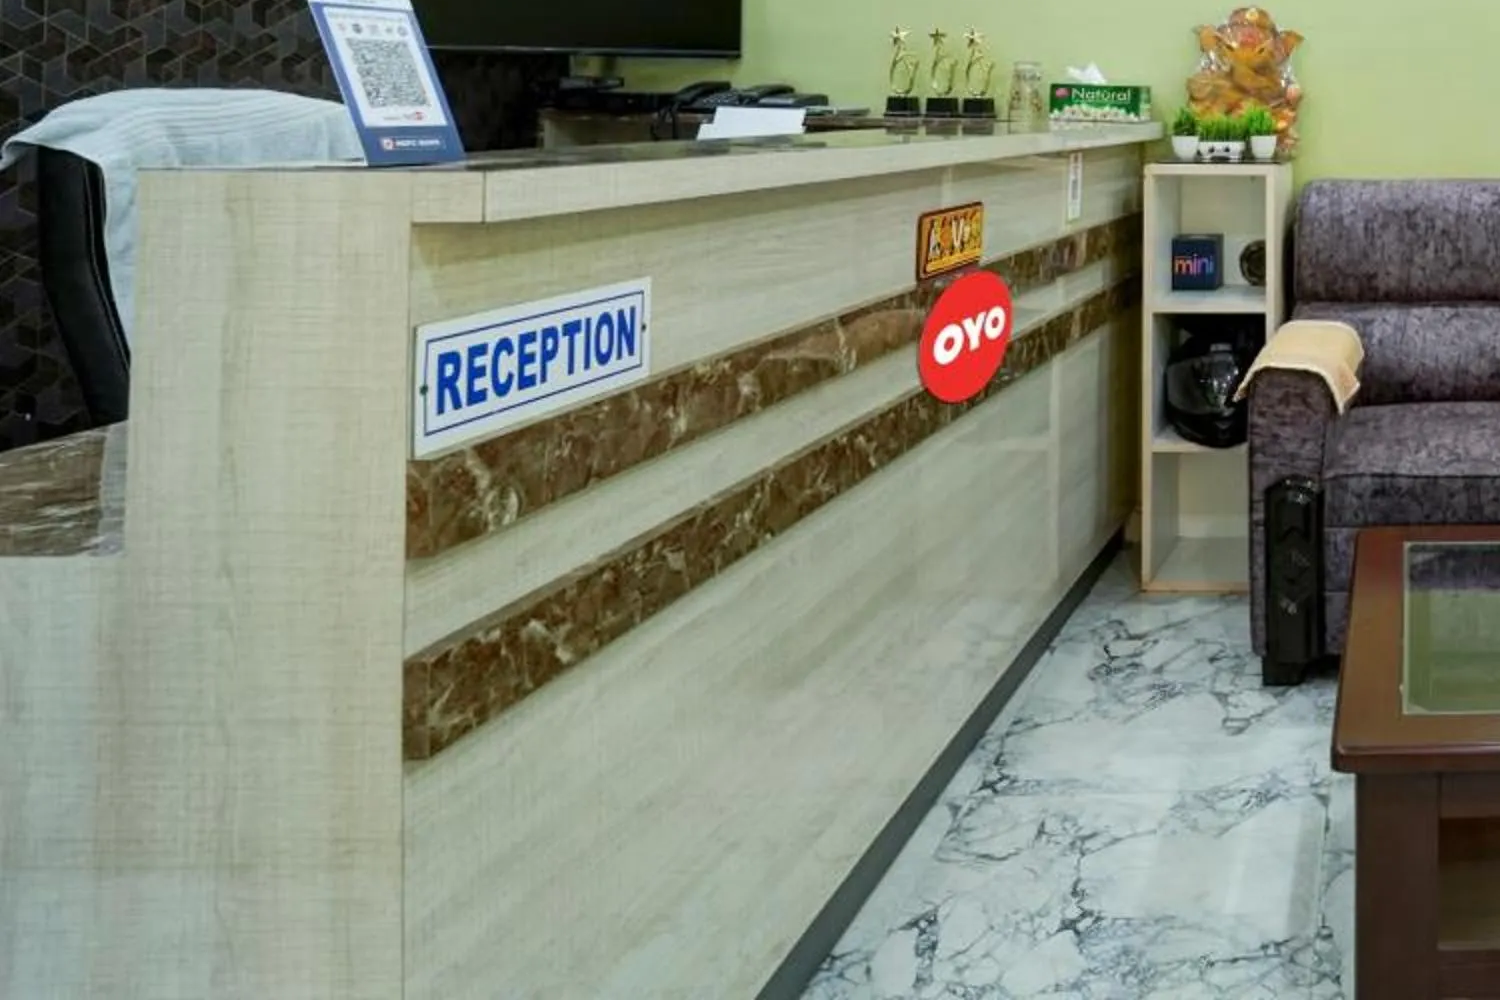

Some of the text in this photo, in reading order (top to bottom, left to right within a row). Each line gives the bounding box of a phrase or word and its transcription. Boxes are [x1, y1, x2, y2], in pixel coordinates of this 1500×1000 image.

[1071, 87, 1131, 102] Natural
[1174, 253, 1215, 275] mini
[933, 305, 1006, 365] OYO
[436, 305, 636, 416] RECEPTION
